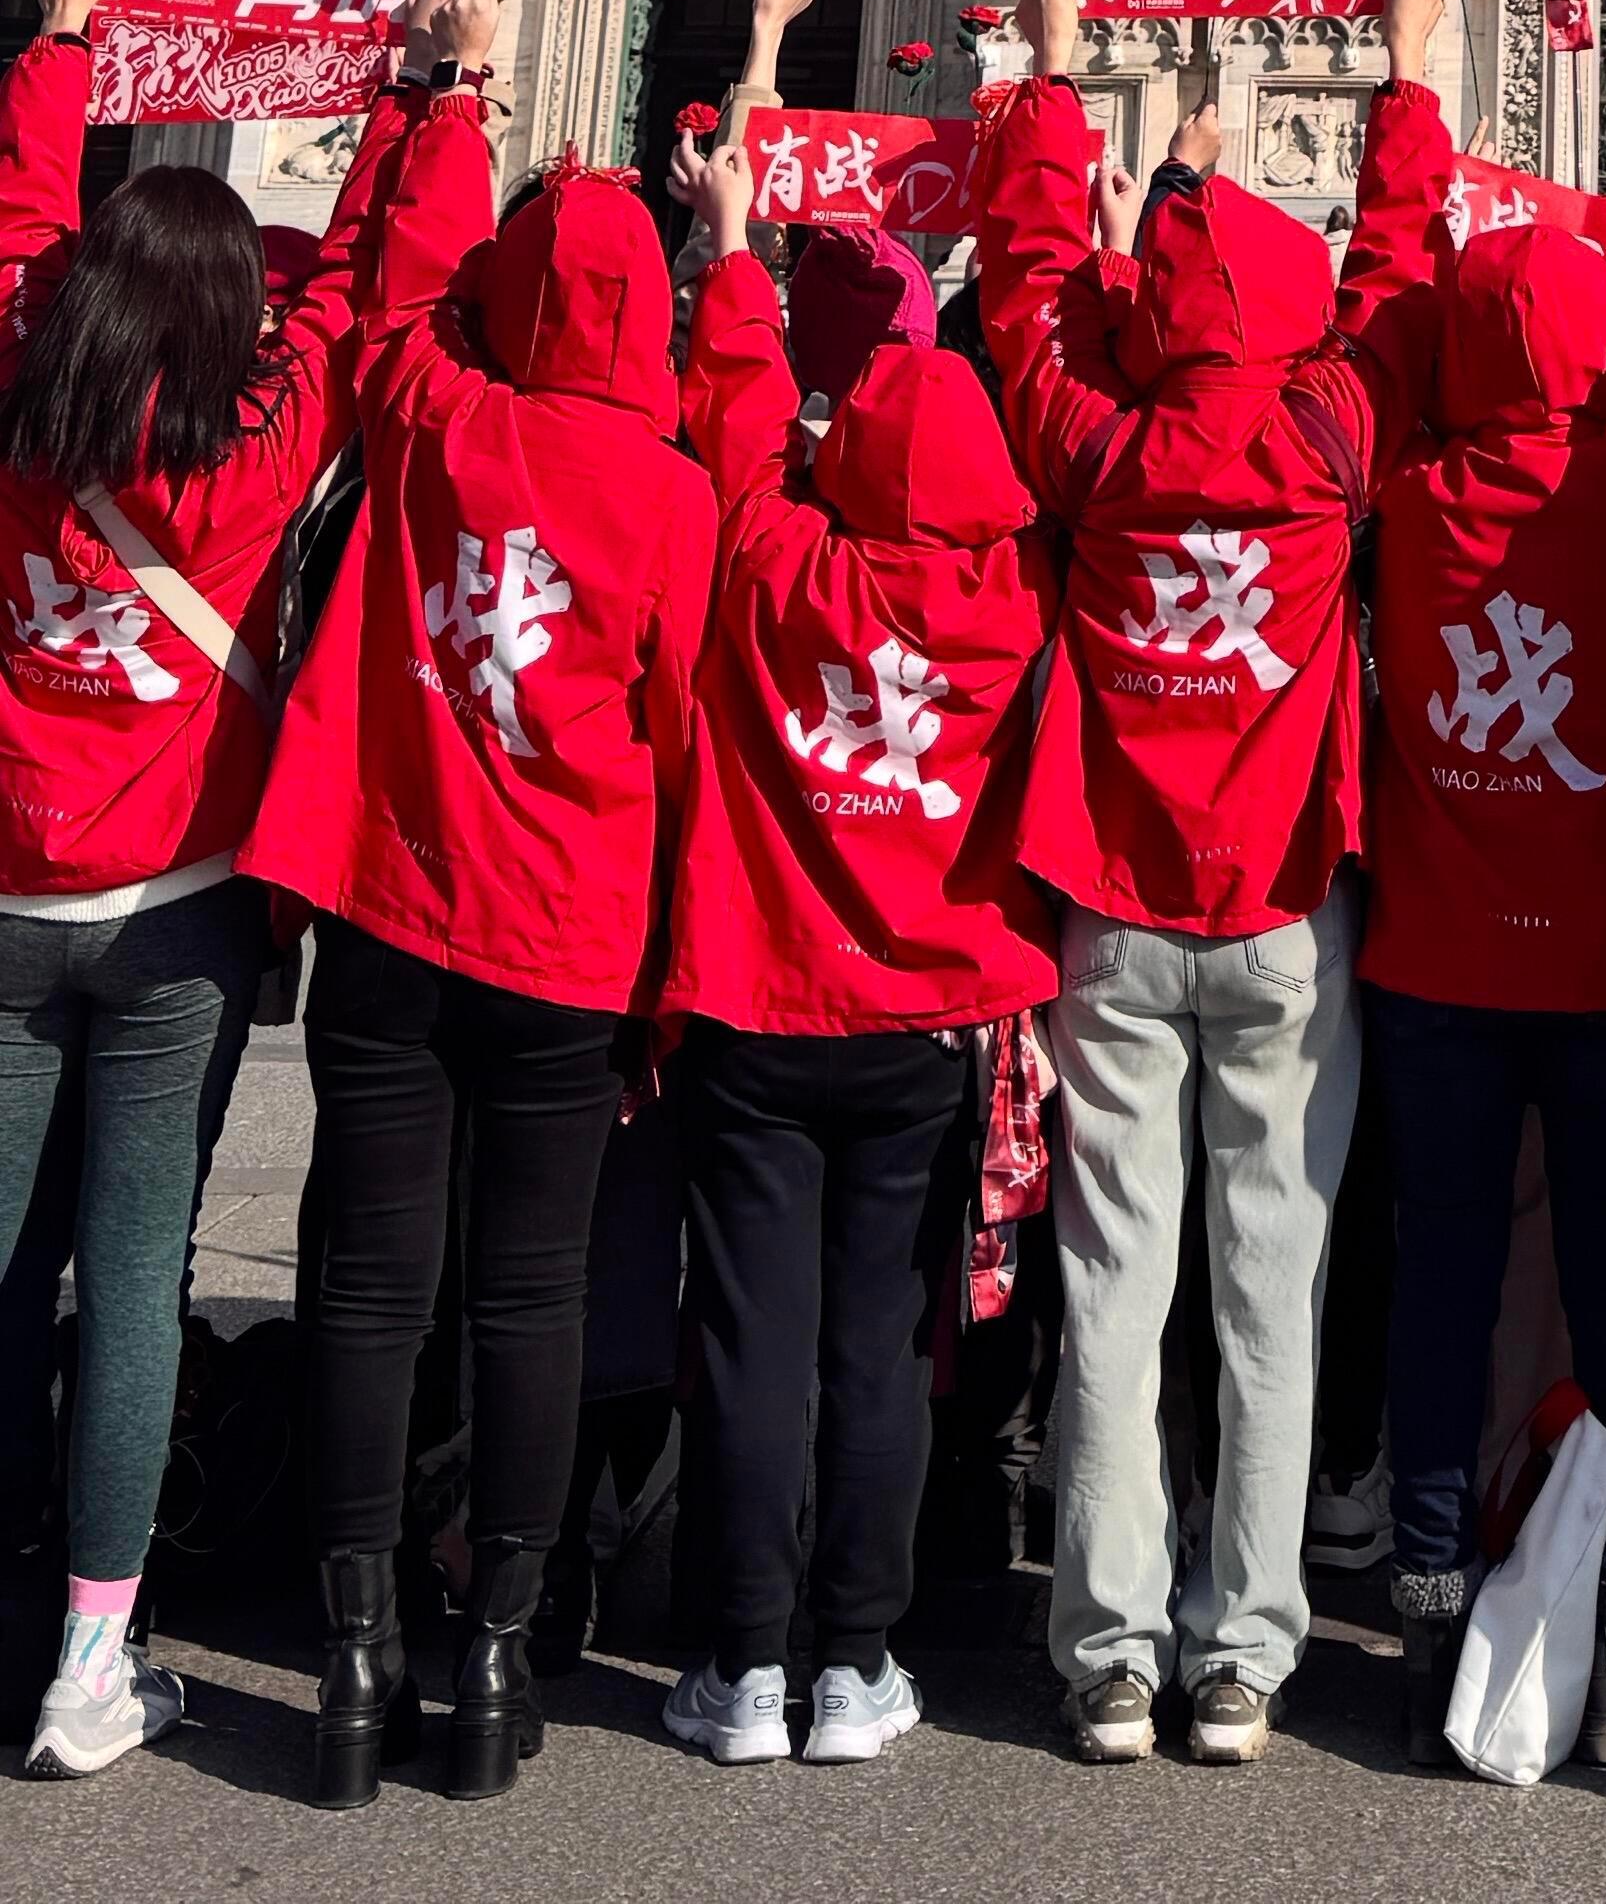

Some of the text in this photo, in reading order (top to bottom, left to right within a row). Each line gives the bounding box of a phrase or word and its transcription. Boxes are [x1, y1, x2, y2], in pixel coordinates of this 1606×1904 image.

[221, 48, 287, 86] 10.05
[235, 73, 306, 119] Xiao
[756, 124, 884, 218] 肖战
[1119, 518, 1298, 692] 战
[49, 671, 110, 697] ZHAN
[1113, 673, 1237, 696] XIAO ZHAN
[785, 636, 962, 821] 战
[1432, 766, 1543, 794] XIAO ZHAN
[835, 792, 904, 816] ZHAN
